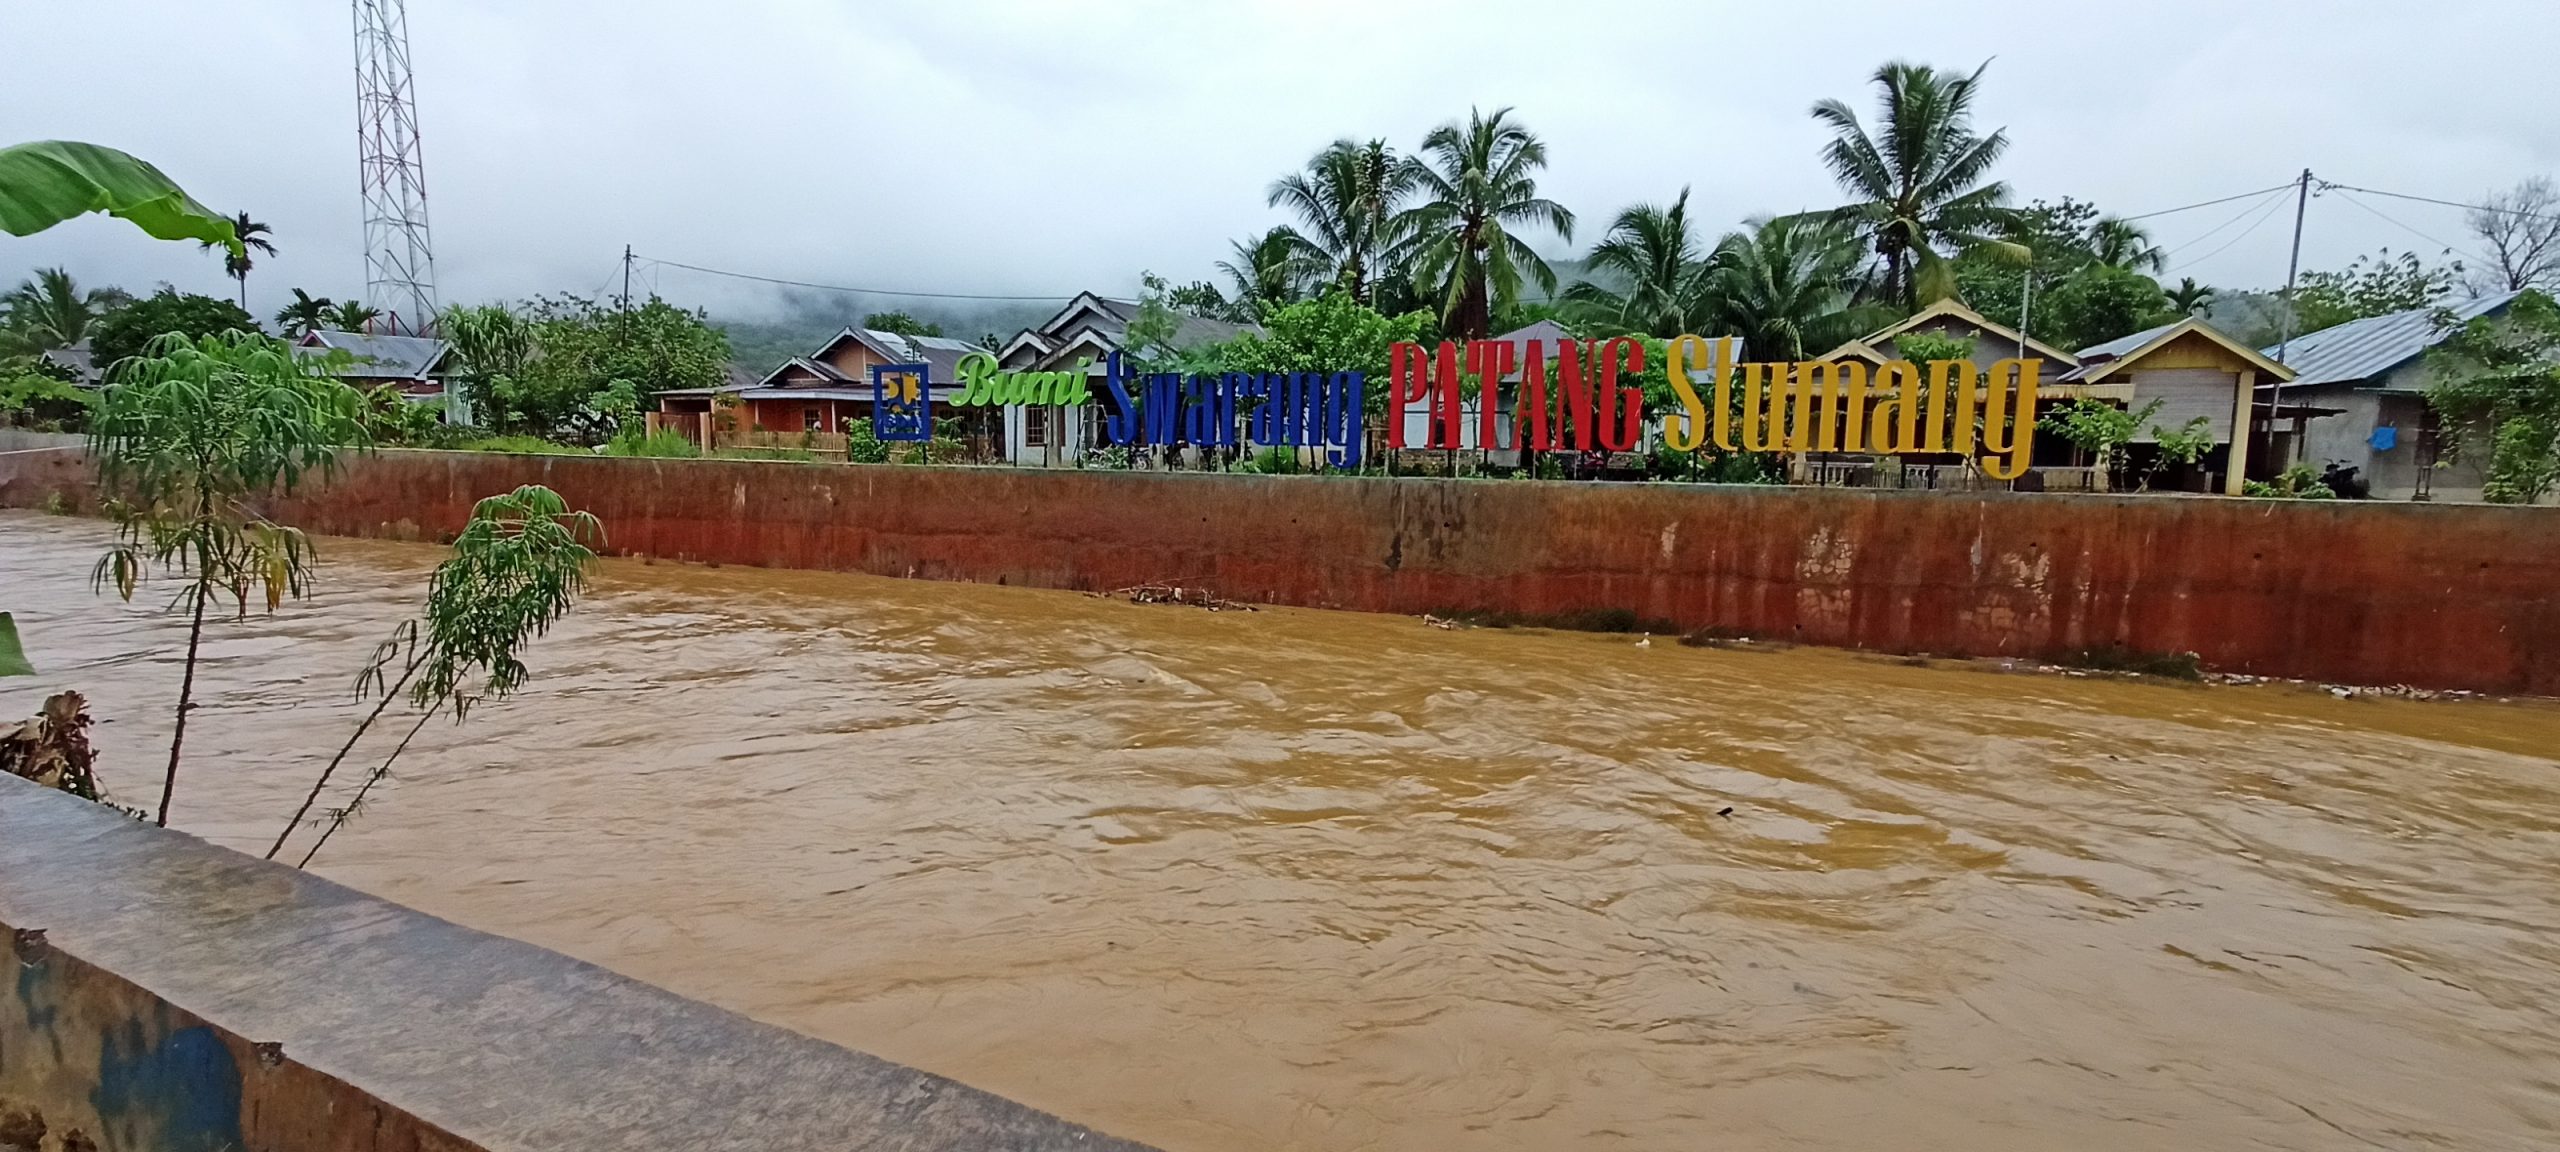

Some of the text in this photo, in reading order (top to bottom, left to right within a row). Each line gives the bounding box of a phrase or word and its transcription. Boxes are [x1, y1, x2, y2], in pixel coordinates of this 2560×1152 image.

[948, 334, 2043, 478] Bumi Swarang PATANG Stumang
